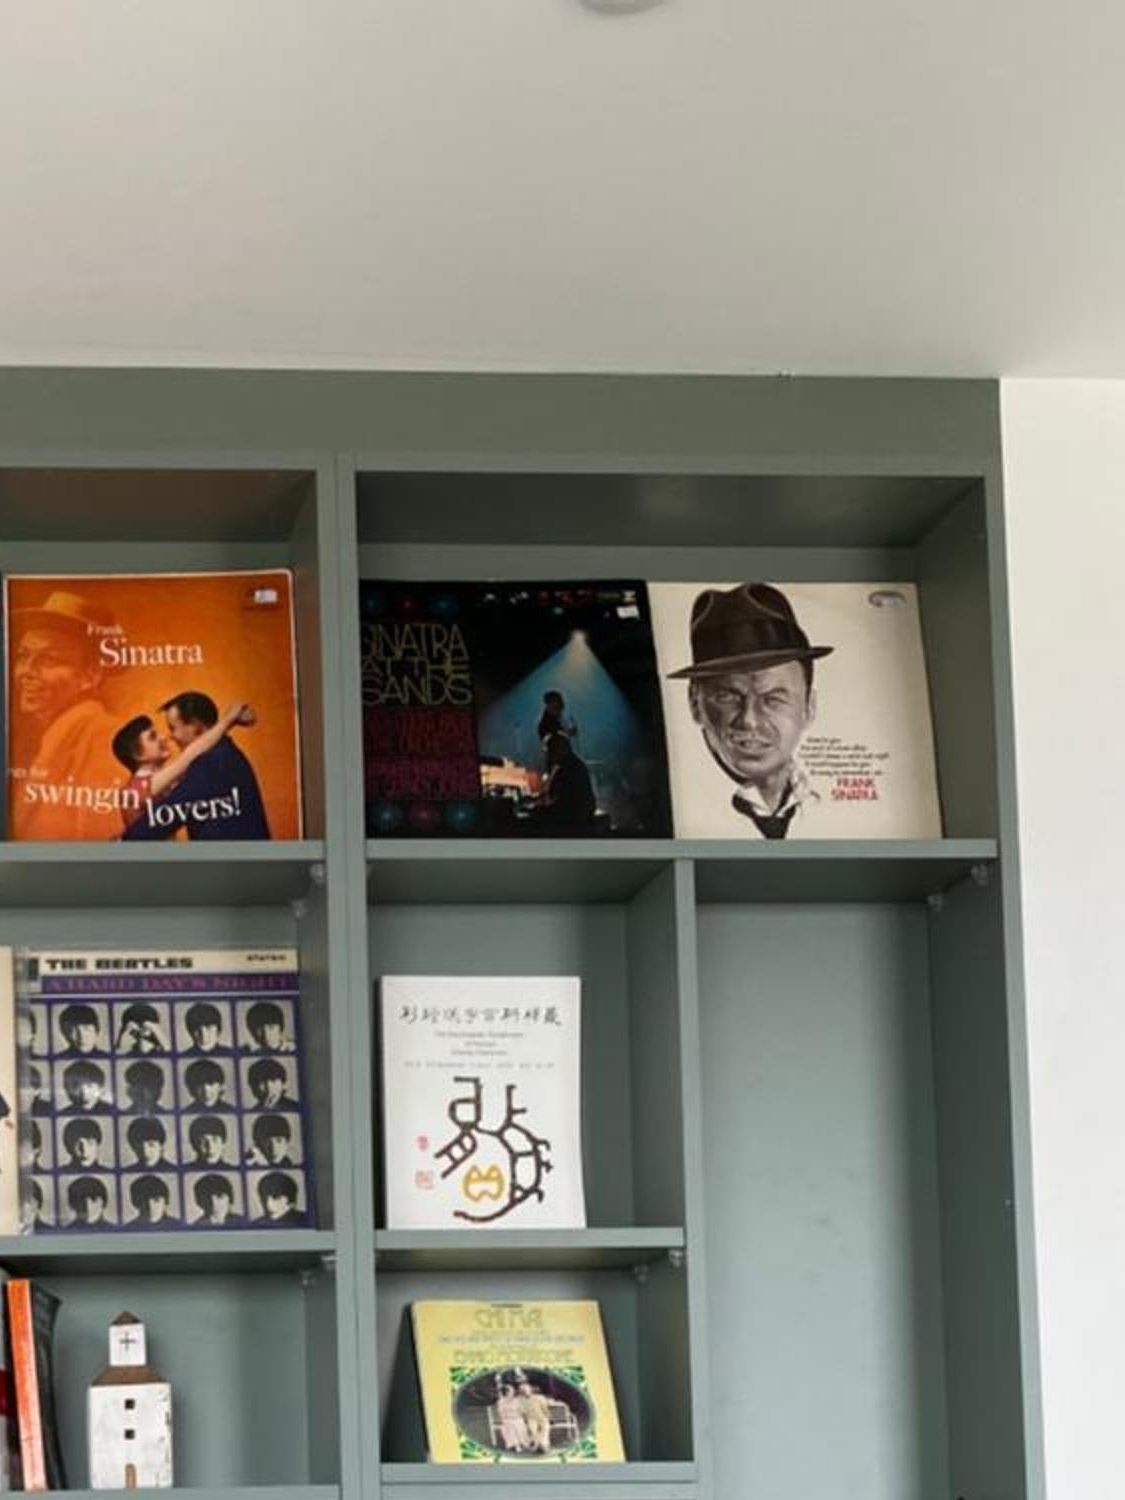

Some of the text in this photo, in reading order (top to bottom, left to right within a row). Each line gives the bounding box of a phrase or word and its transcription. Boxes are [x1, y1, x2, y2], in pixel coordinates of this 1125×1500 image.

[87, 623, 122, 636] Frank
[99, 637, 203, 667] Sinatra
[25, 776, 148, 812] swingin'
[146, 787, 241, 827] lovers!
[46, 958, 193, 970] THE BEATLES
